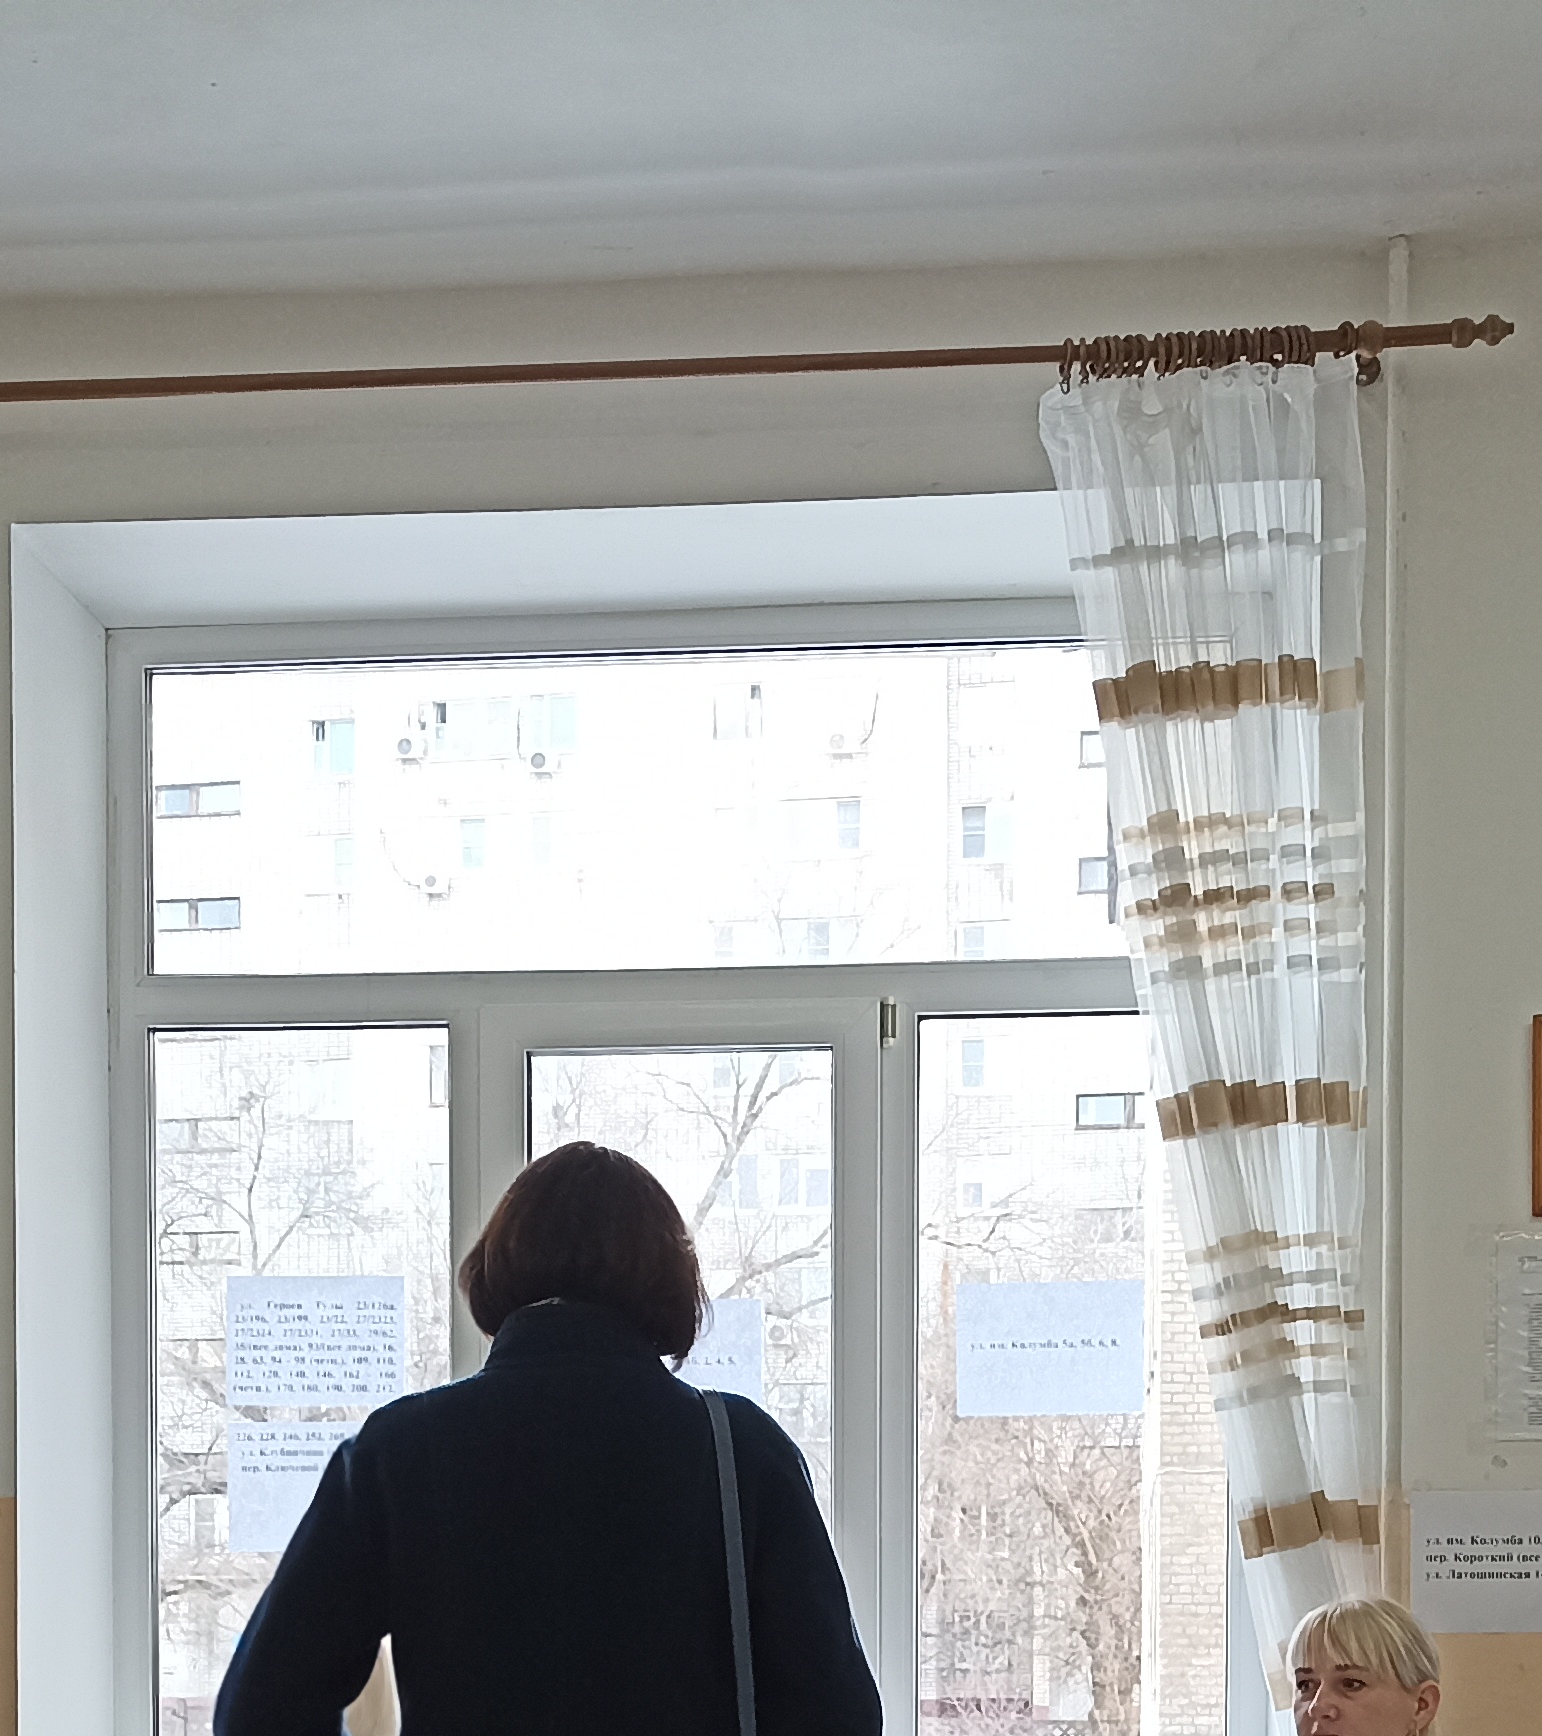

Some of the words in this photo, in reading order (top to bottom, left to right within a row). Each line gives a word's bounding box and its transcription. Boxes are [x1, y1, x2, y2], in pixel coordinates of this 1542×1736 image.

[1426, 1537, 1443, 1547] ул.
[1470, 1535, 1524, 1548] Колумба
[1454, 1553, 1514, 1565] Короткий
[1517, 1553, 1541, 1564] (все
[1426, 1572, 1443, 1582] ул.
[1446, 1569, 1531, 1580] Латошинская
